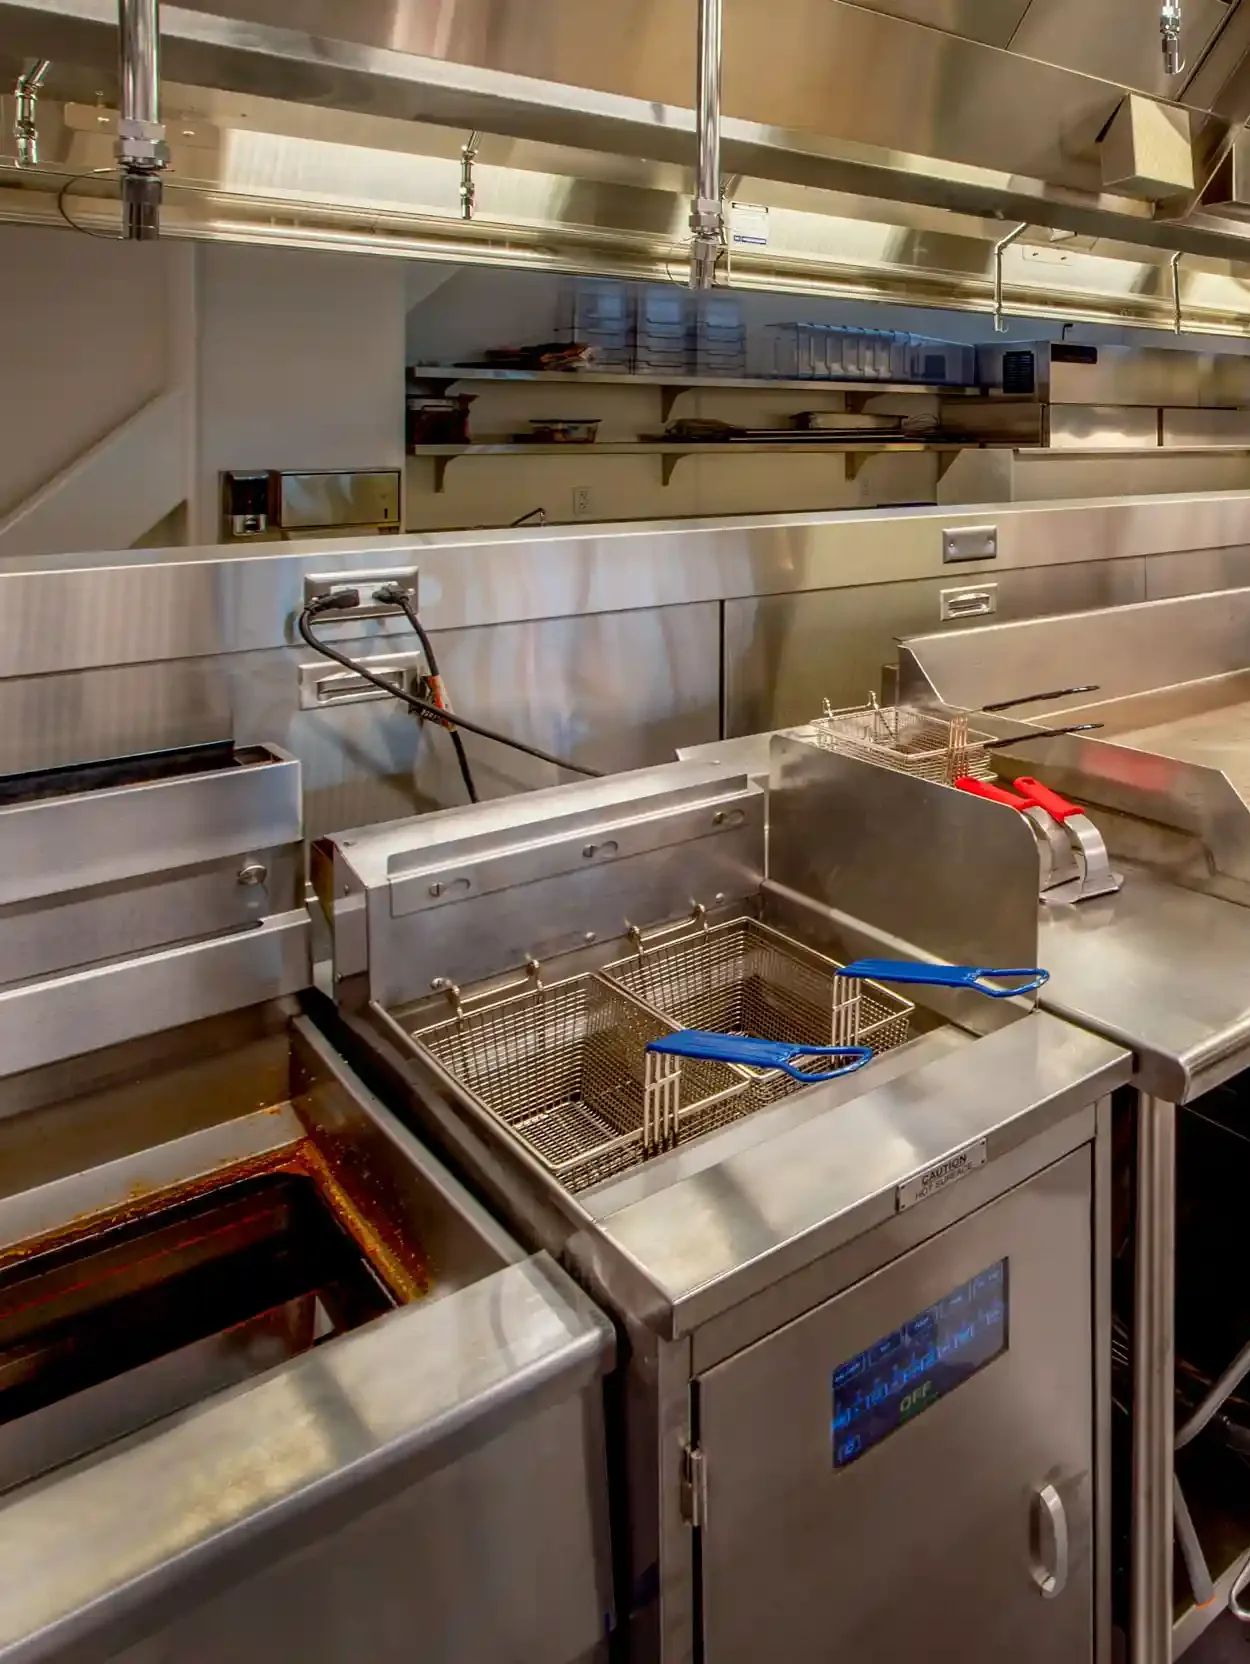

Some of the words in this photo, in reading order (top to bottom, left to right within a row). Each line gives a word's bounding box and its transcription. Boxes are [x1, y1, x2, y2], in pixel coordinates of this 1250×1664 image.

[921, 1153, 967, 1186] CAUTION
[915, 1180, 933, 1199] HOT
[900, 1380, 932, 1412] OFF
